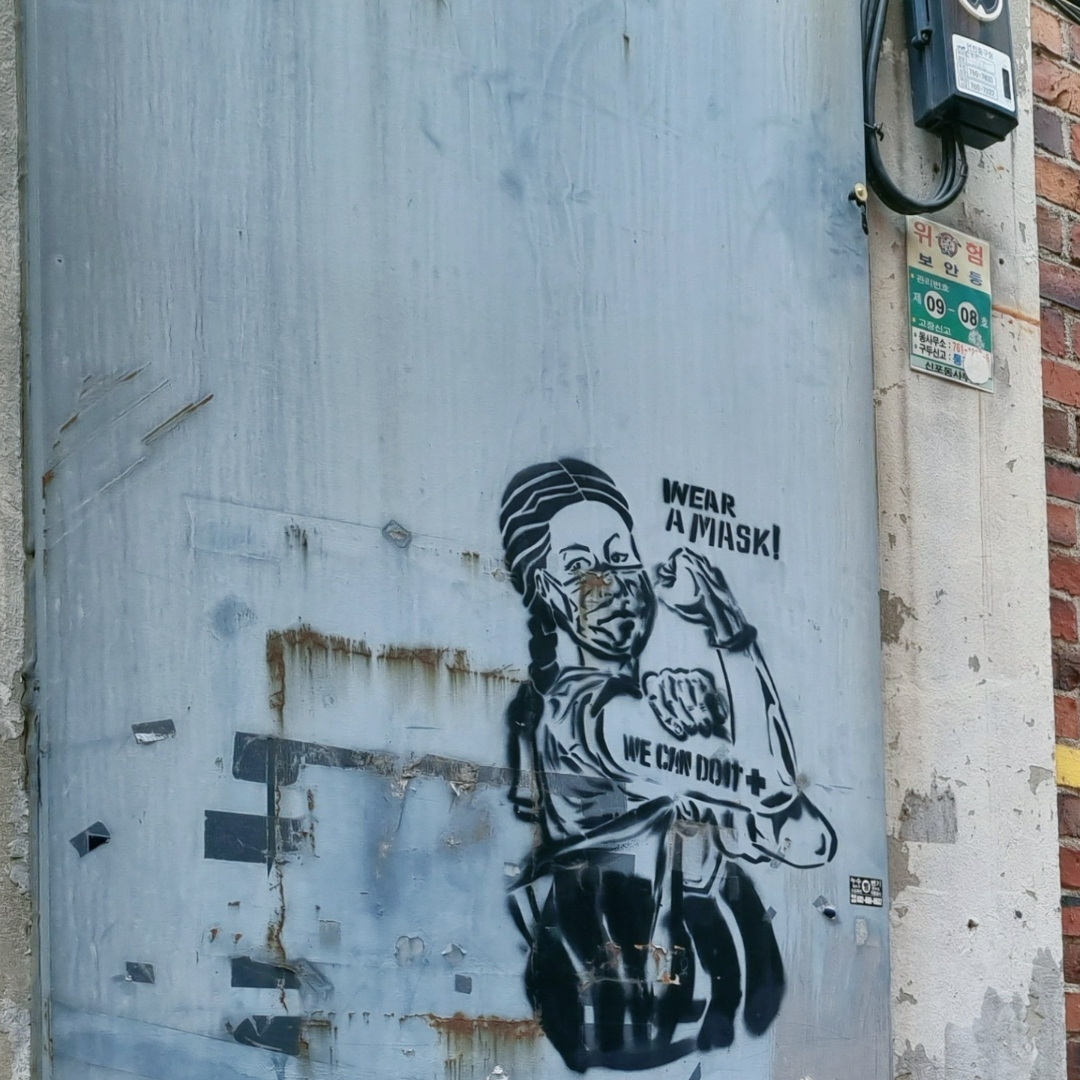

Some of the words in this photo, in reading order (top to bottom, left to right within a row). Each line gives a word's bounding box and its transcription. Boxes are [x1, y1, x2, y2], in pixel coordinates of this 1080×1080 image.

[918, 318, 952, 336] 고장신고
[662, 477, 737, 518] WEAR
[665, 507, 685, 535] A
[689, 512, 781, 561] MASK!
[623, 733, 652, 768] WE
[655, 743, 692, 777] CAN
